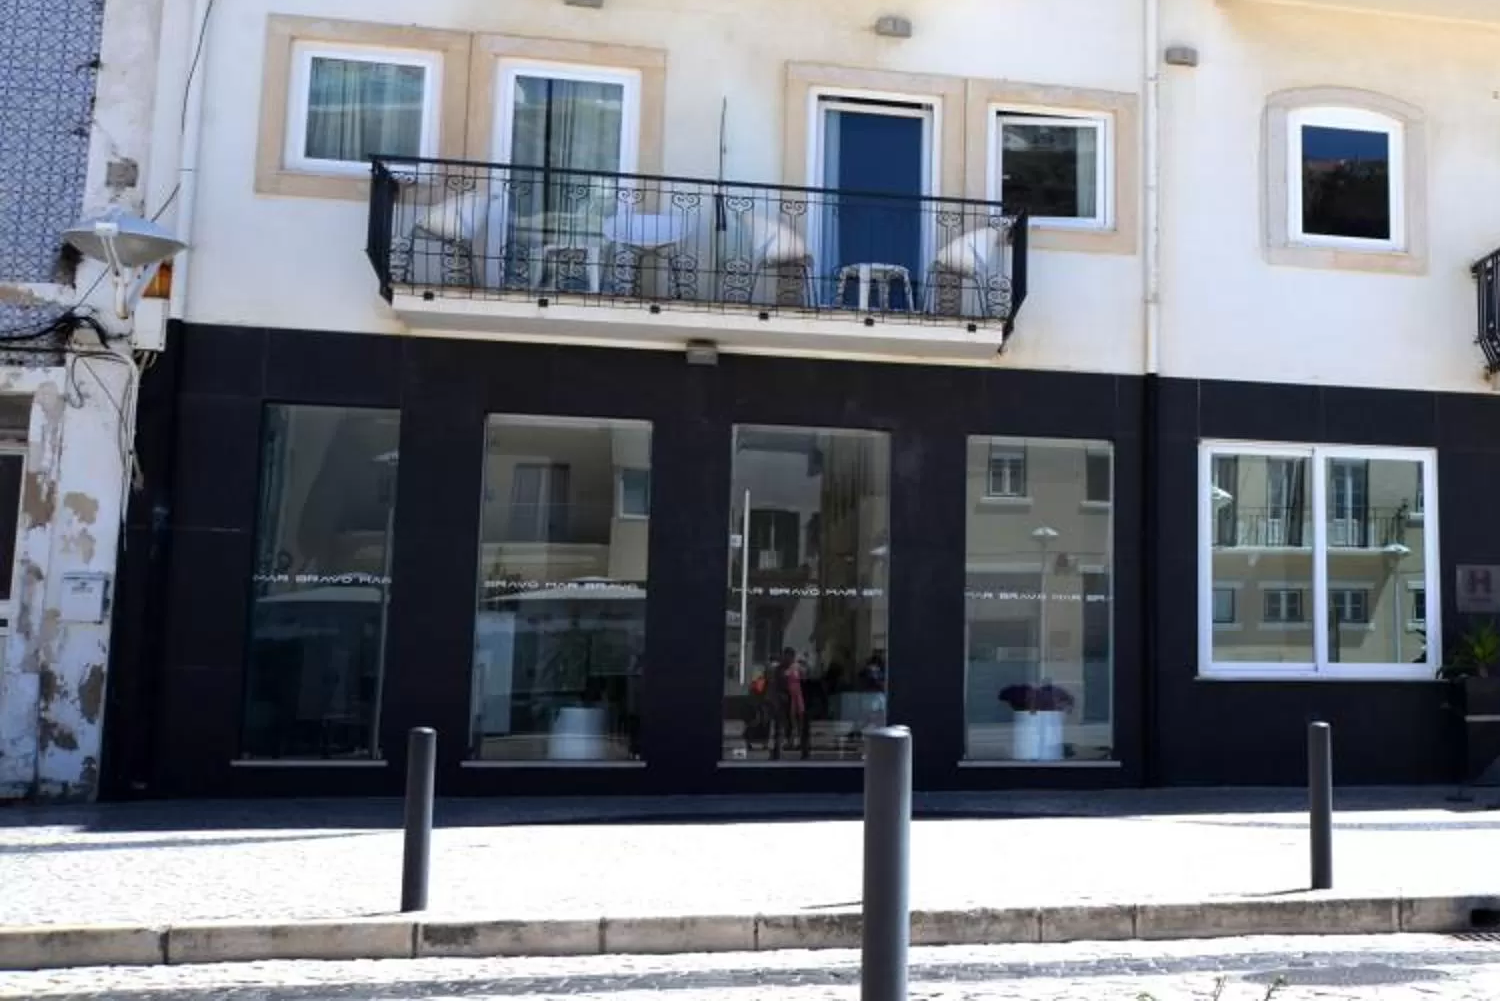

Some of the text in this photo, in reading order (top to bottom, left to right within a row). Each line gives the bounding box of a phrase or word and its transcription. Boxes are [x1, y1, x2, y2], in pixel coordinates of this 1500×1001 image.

[252, 574, 289, 583] MAR
[295, 574, 353, 584] BRAVO
[483, 580, 539, 589] BRAVO
[769, 587, 821, 596] BRAVO
[825, 588, 857, 597] MAR
